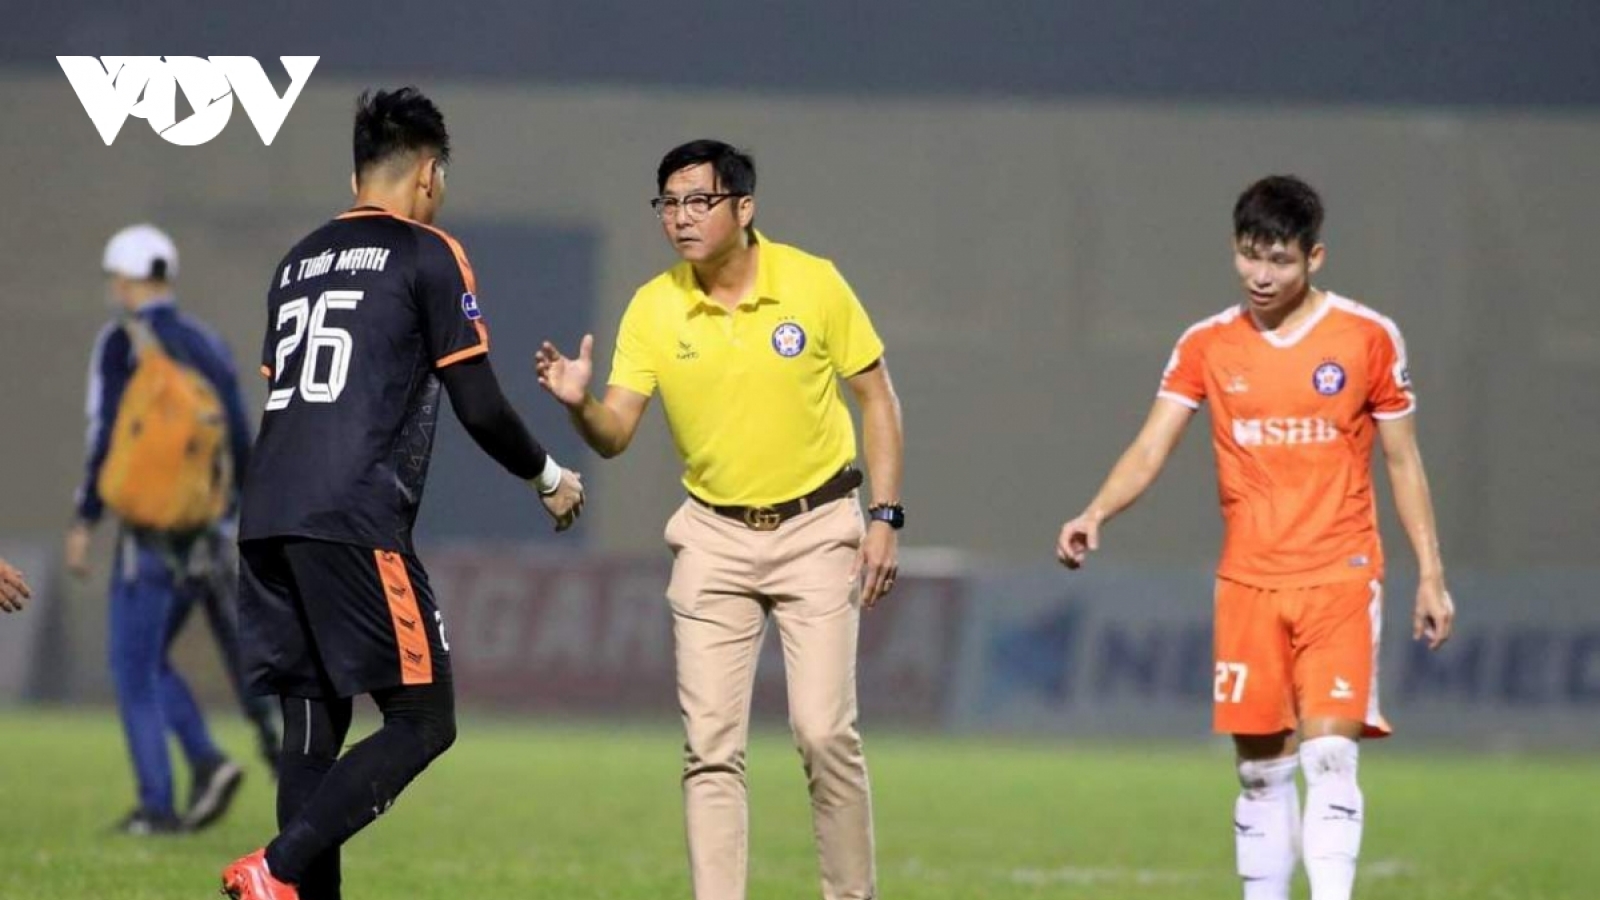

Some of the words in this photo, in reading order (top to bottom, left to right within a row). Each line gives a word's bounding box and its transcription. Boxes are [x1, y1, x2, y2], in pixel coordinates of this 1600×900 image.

[264, 290, 365, 411] 26
[1264, 417, 1339, 444] SHB
[1214, 661, 1248, 703] 27
